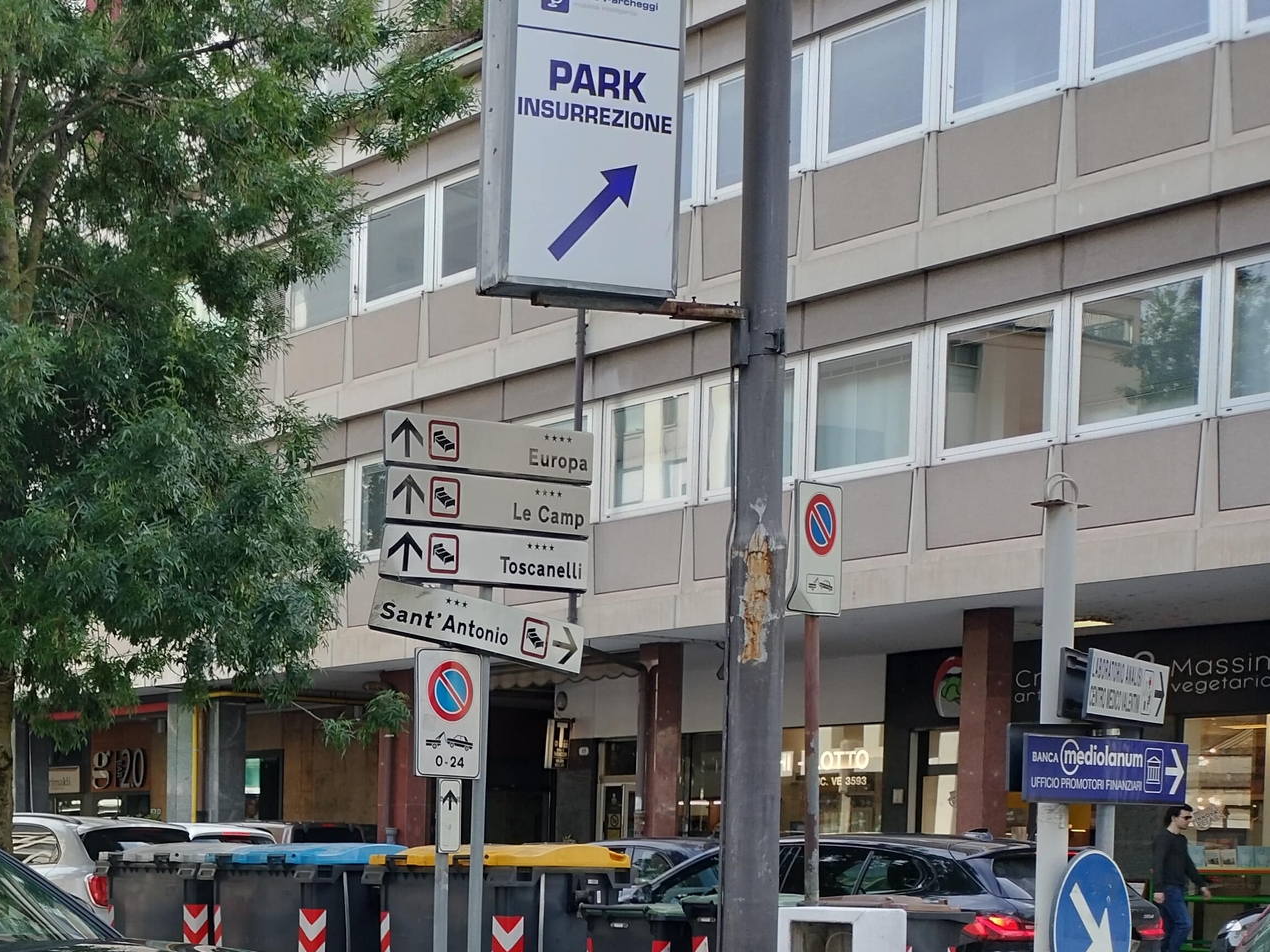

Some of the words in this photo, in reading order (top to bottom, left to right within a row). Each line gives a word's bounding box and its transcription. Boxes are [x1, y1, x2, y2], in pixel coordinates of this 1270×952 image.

[603, 0, 658, 12] archeggi
[549, 59, 647, 103] PARK
[517, 97, 672, 135] INSURREZIONE
[528, 448, 588, 473] Europa
[513, 502, 532, 522] Le
[538, 505, 584, 530] Camp
[499, 556, 582, 580] Toscanelli
[380, 601, 509, 646] Sant'Antonio
[1032, 751, 1059, 763] BANCA
[1063, 744, 1143, 768] mediolanum
[831, 776, 842, 786] VE
[845, 776, 867, 786] 3593
[1030, 776, 1059, 789] UFFICIO
[1060, 777, 1105, 790] PROMOTORI
[1105, 779, 1142, 791] FINANZIARI
